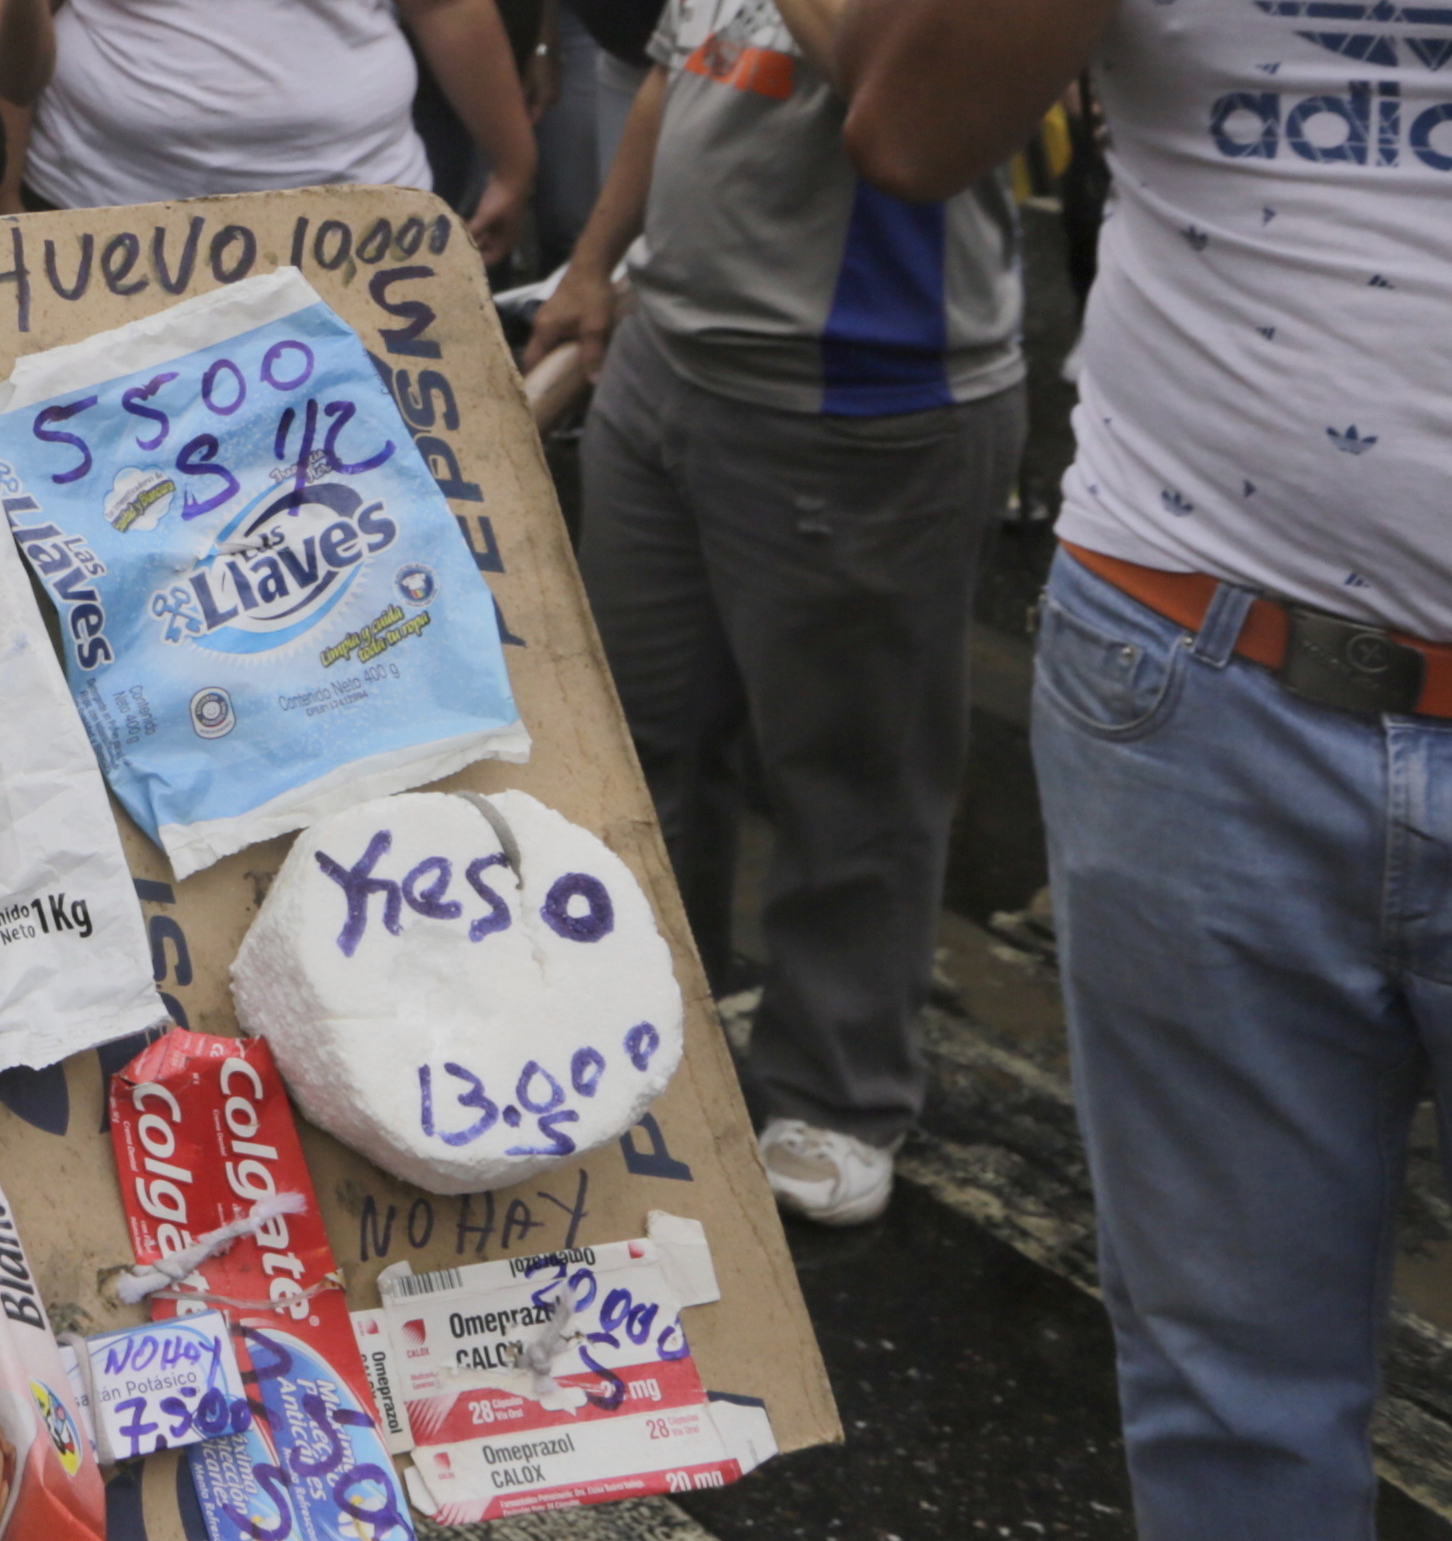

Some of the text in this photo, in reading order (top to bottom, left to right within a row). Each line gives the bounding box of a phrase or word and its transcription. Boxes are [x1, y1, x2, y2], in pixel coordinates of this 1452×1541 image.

[63, 537, 108, 577] Las
[188, 501, 397, 631] Llaves
[2, 495, 113, 669] Llaves
[279, 688, 331, 712] Contenido
[331, 674, 362, 696] Neto
[363, 663, 385, 683] 400
[390, 663, 401, 679] g
[0, 923, 36, 946] Neto
[219, 1056, 311, 1321] Colgate
[360, 1168, 589, 1261] NO HAY
[406, 1347, 431, 1359] CALOX
[125, 1371, 198, 1398] Potásico
[371, 1350, 404, 1435] Omeprazol
[628, 1377, 663, 1402] mg
[467, 1400, 495, 1425] 28
[646, 1417, 670, 1440] 28
[482, 1432, 576, 1466] Omeprazol
[491, 1464, 547, 1489] CALOX
